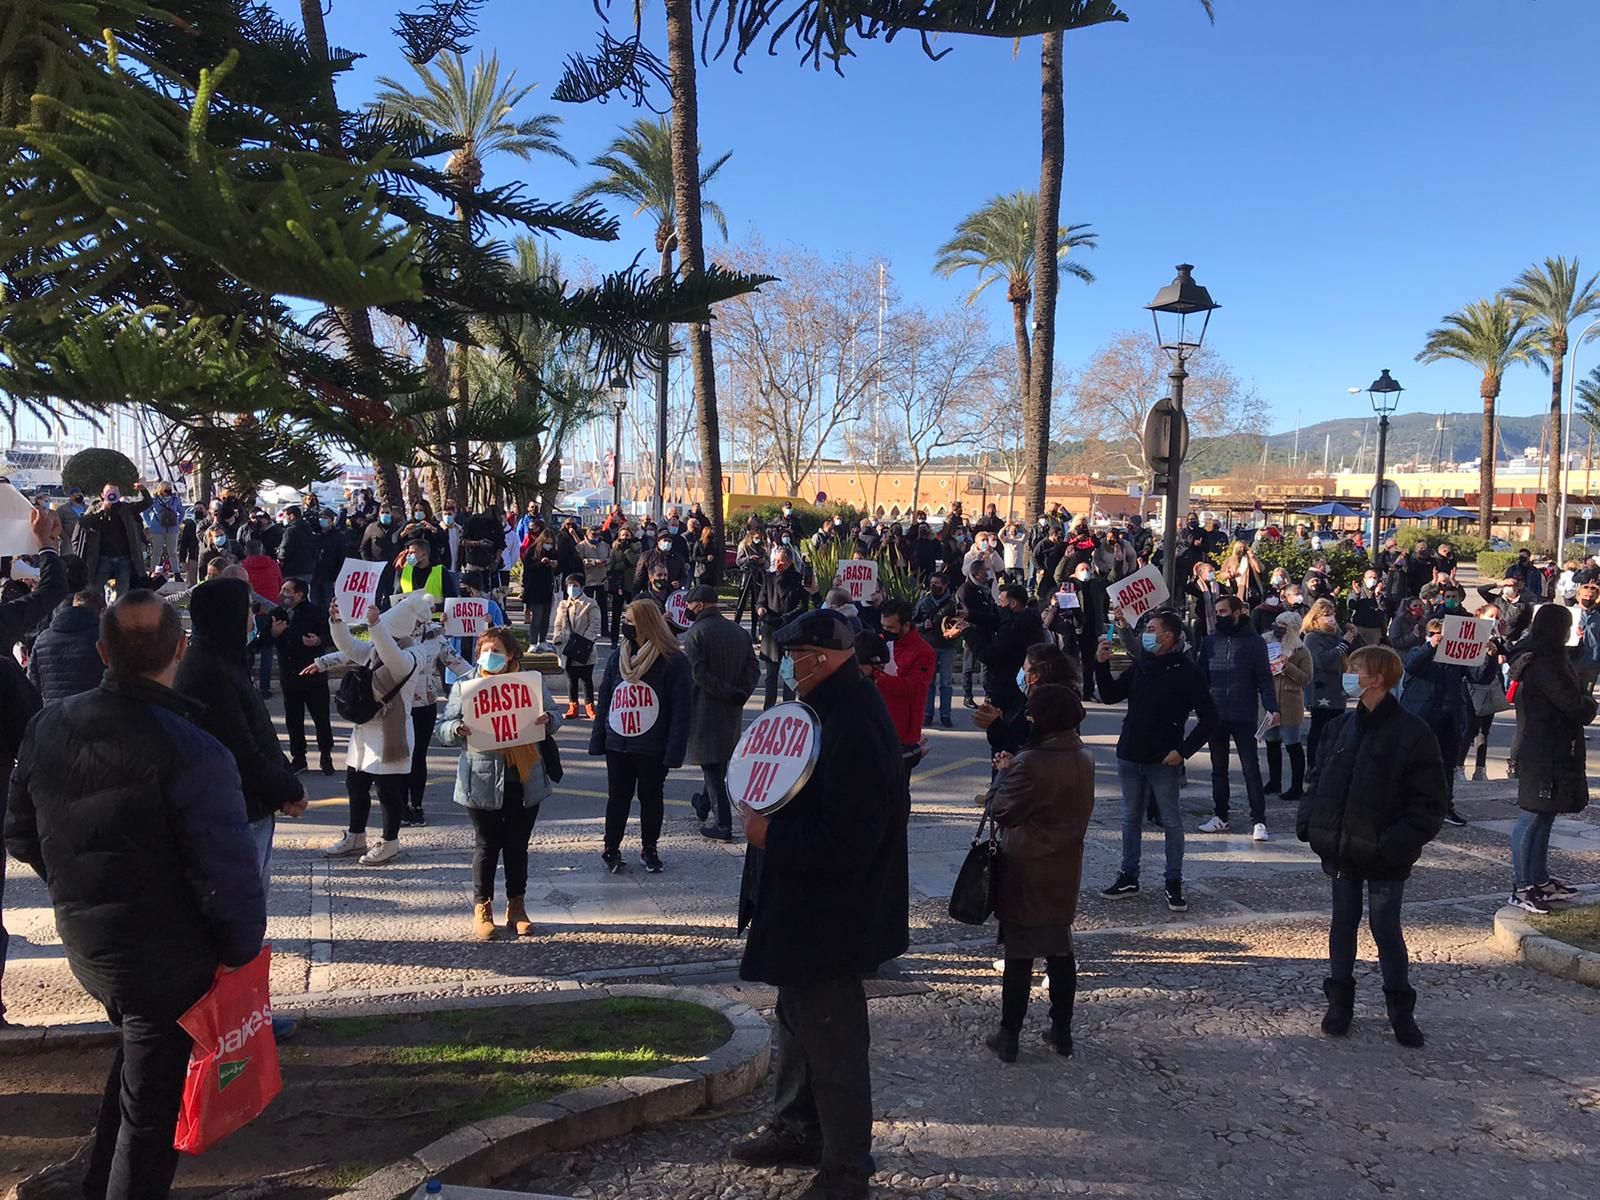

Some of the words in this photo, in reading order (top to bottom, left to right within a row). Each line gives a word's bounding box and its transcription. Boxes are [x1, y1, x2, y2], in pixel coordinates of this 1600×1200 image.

[843, 565, 872, 582] ¡BASTA
[850, 582, 863, 597] YA!
[1117, 577, 1156, 609] ¡BASTA
[453, 602, 484, 618] ¡BASTA
[672, 594, 688, 609] ¡BA
[1131, 597, 1150, 615] YA!
[461, 618, 476, 633] YA!
[1458, 620, 1477, 640] YA!
[1444, 639, 1483, 660] ¡BASTA
[473, 683, 532, 719] ¡BASTA
[611, 684, 653, 712] ¡BASTA
[491, 713, 518, 743] YA!
[620, 711, 641, 734] YA!
[741, 716, 810, 758] ¡BASTA
[742, 761, 780, 802] YA!
